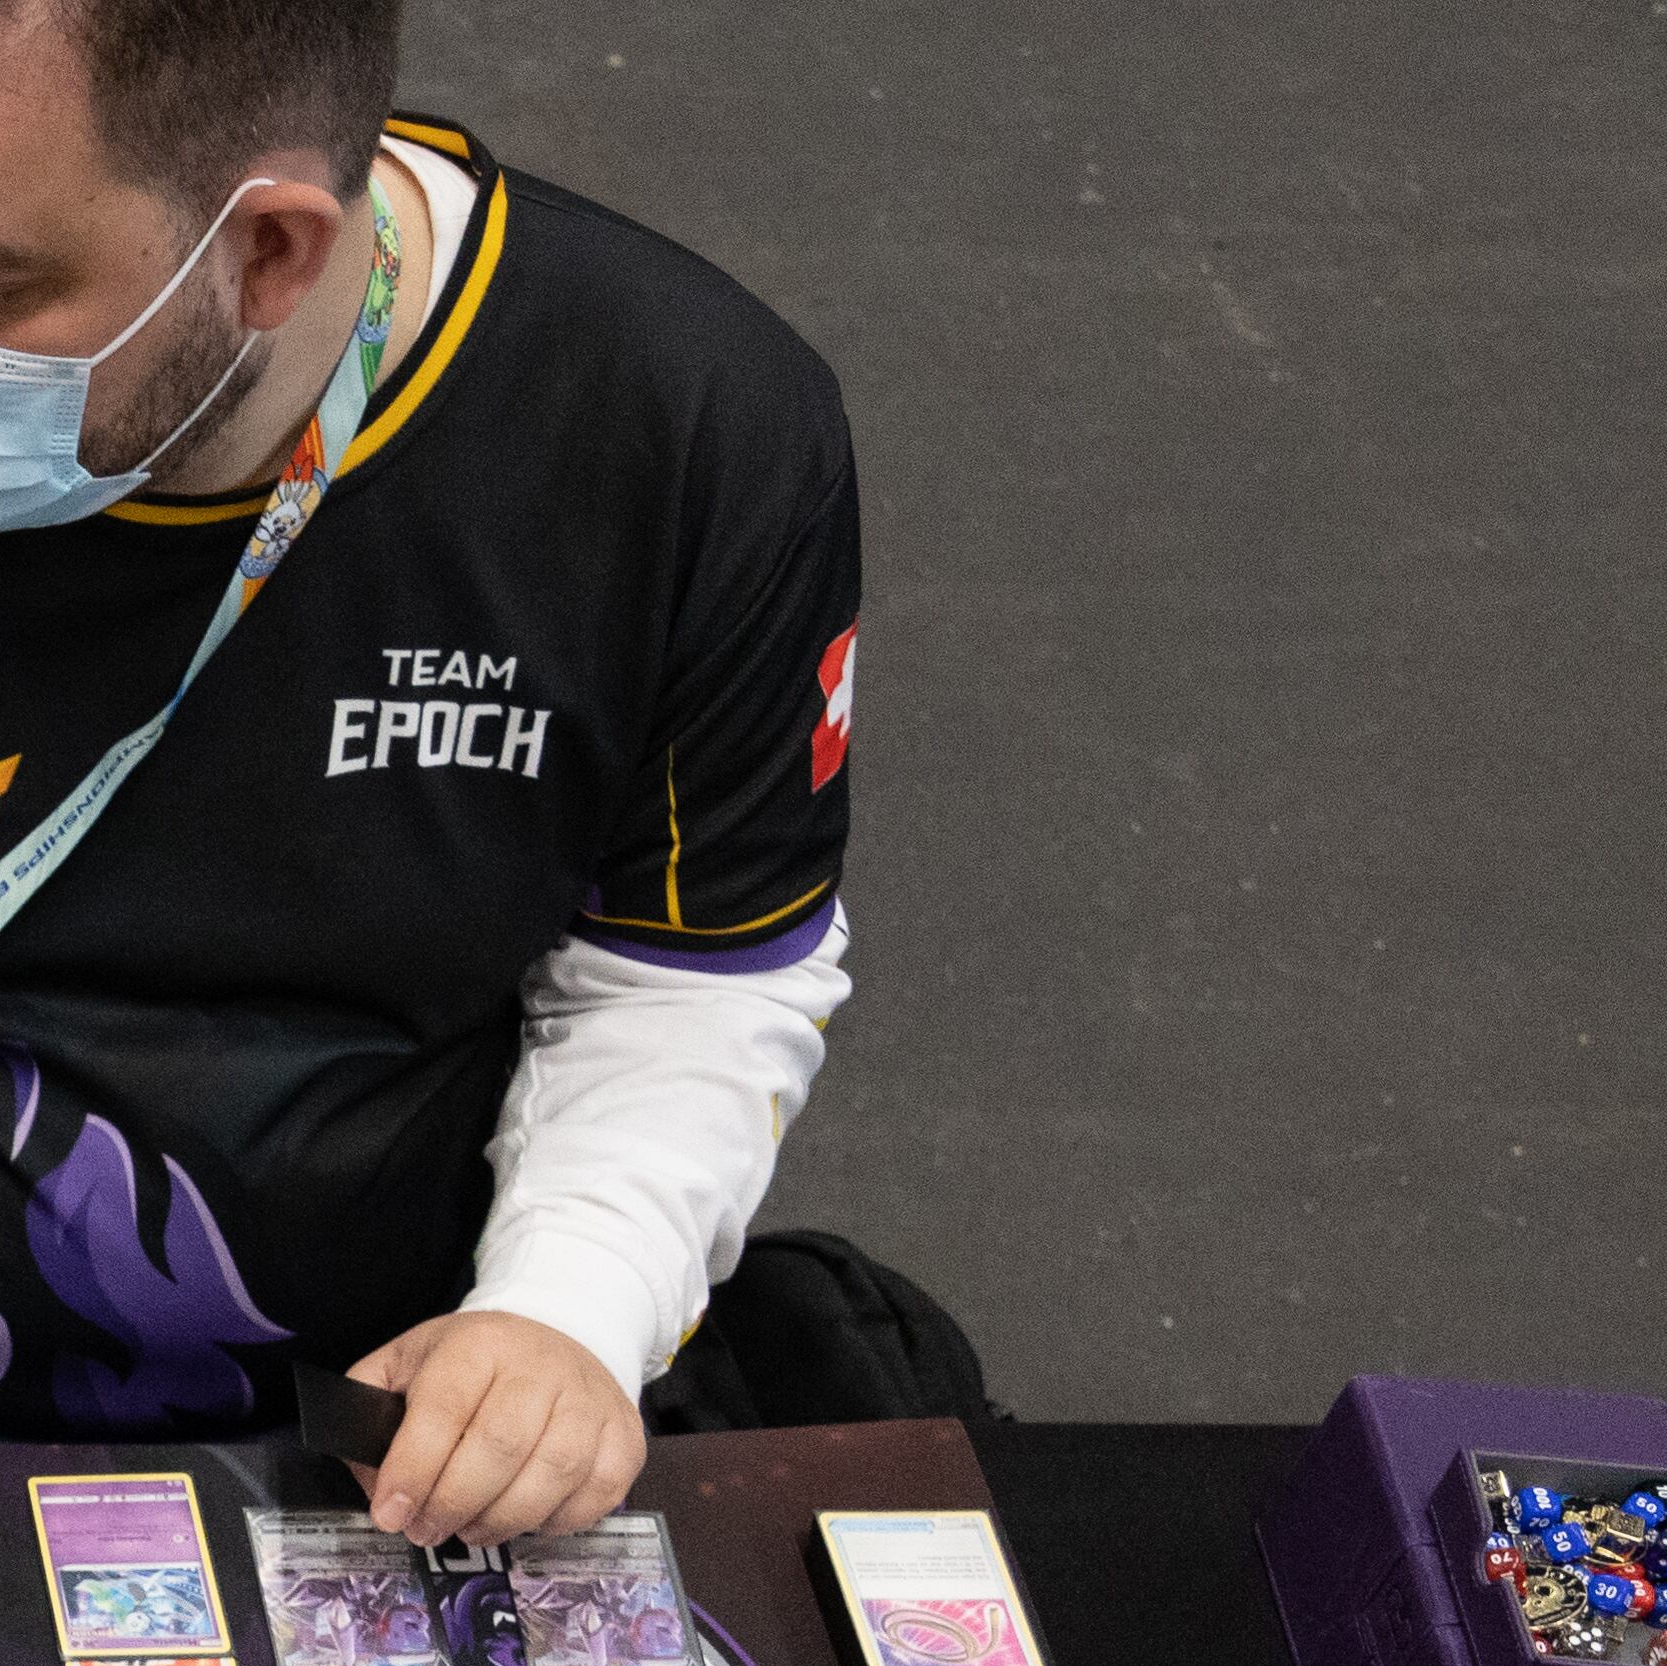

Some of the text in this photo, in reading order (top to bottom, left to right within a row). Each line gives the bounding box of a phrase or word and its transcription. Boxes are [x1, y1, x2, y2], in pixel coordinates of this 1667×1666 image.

[382, 648, 517, 691] TEAM
[324, 698, 552, 779] EPOCH
[1552, 1530, 1572, 1553] 50
[1594, 1583, 1618, 1599] 30
